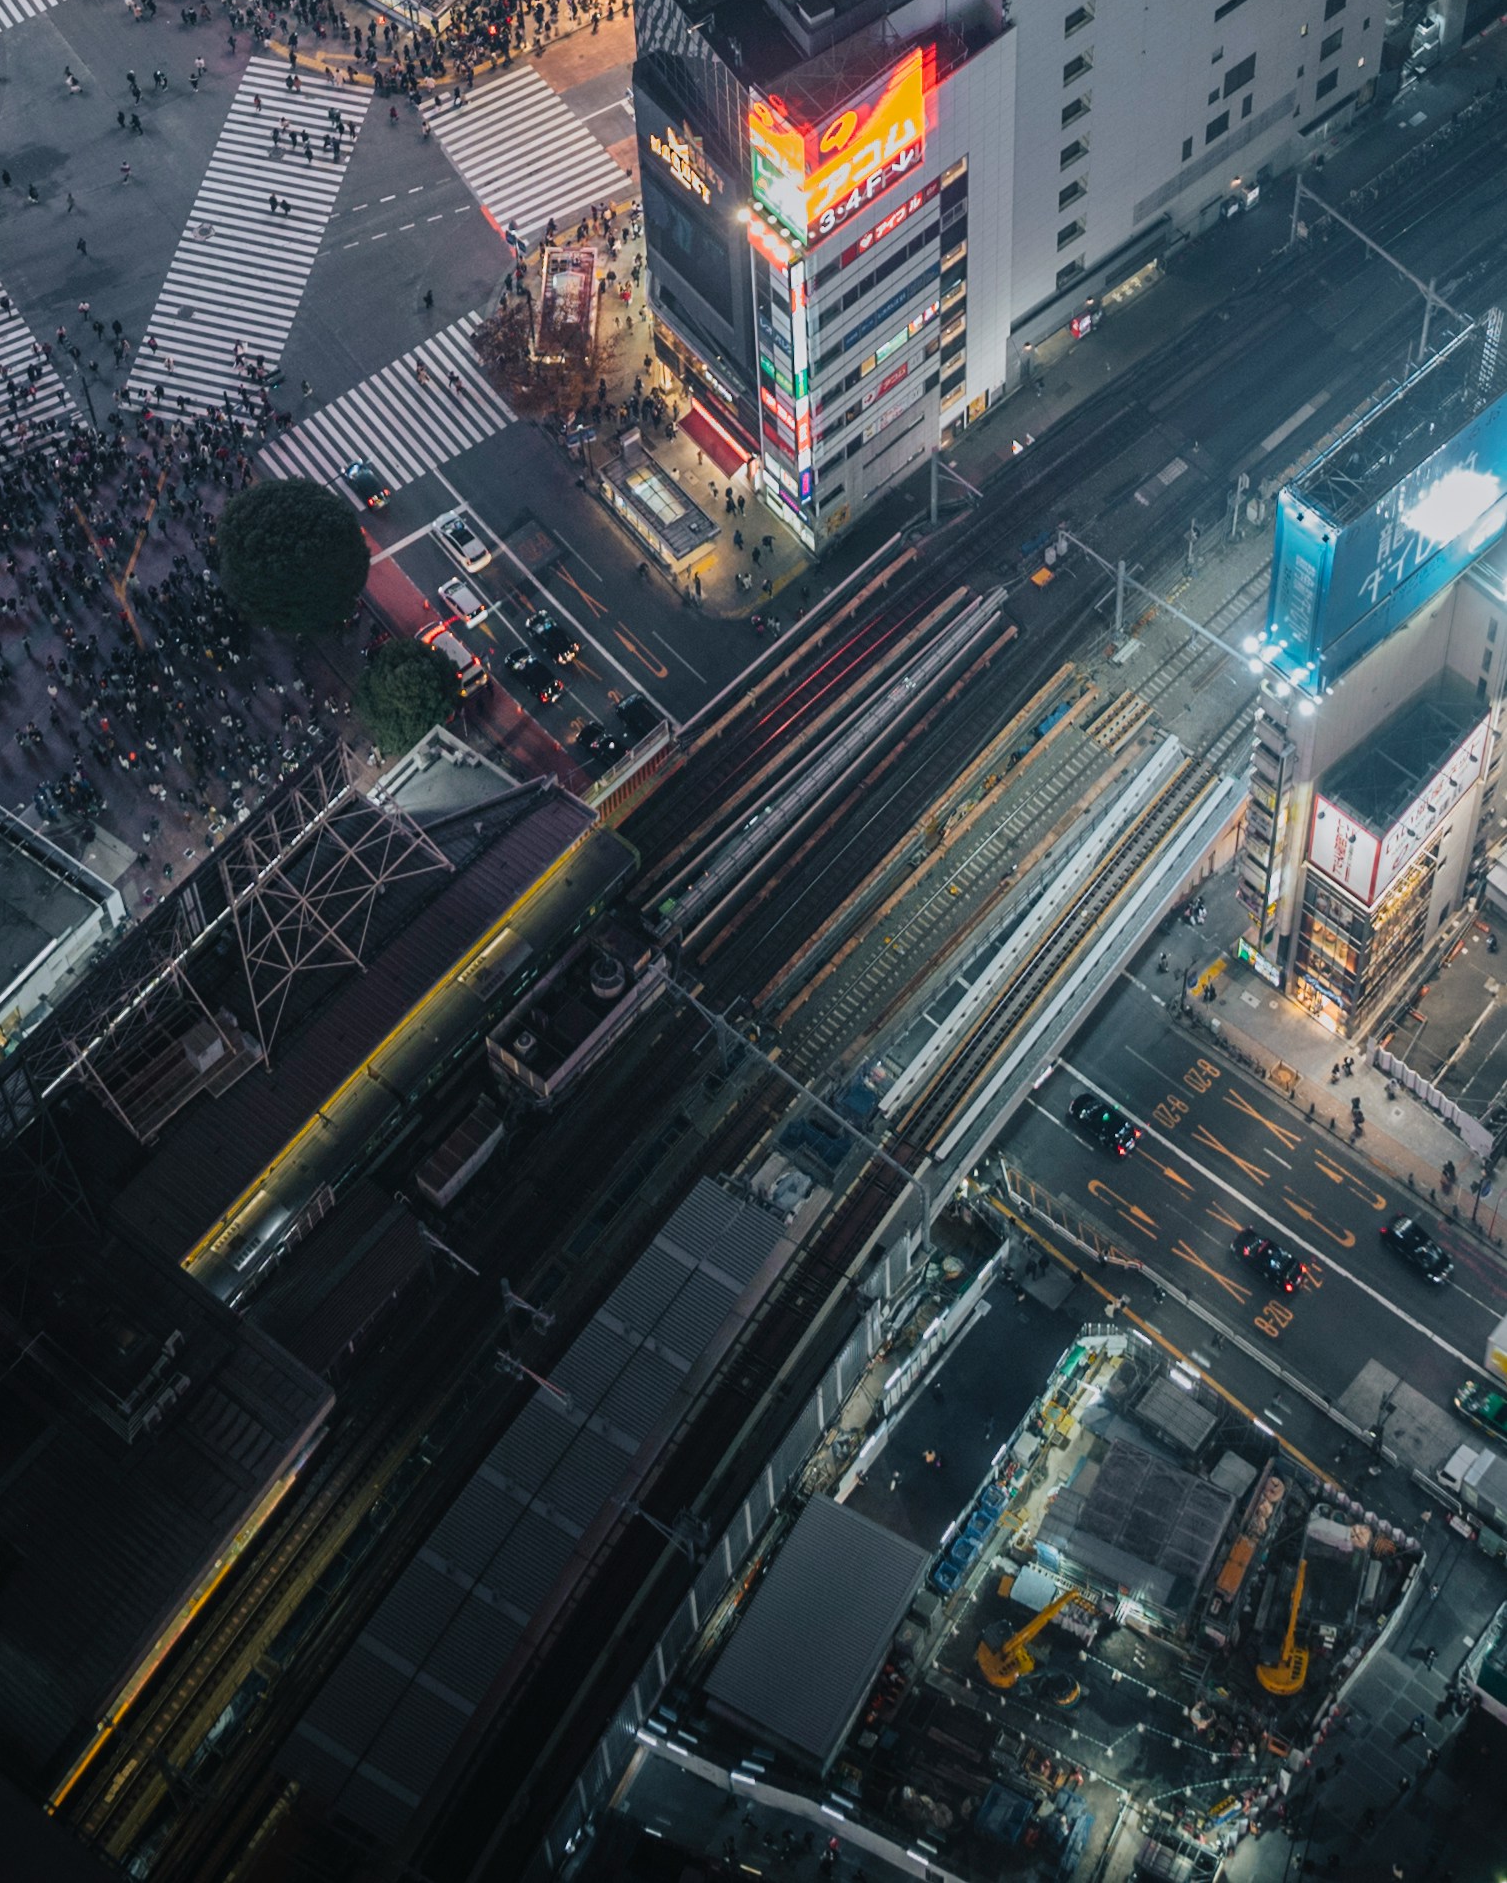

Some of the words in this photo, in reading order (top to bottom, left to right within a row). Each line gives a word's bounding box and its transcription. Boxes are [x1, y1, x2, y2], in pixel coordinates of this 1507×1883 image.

[814, 117, 916, 215] アコム
[1183, 1058, 1222, 1094] 8-20
[1152, 1094, 1189, 1130] 8-20
[1254, 1300, 1294, 1338] 8-20
